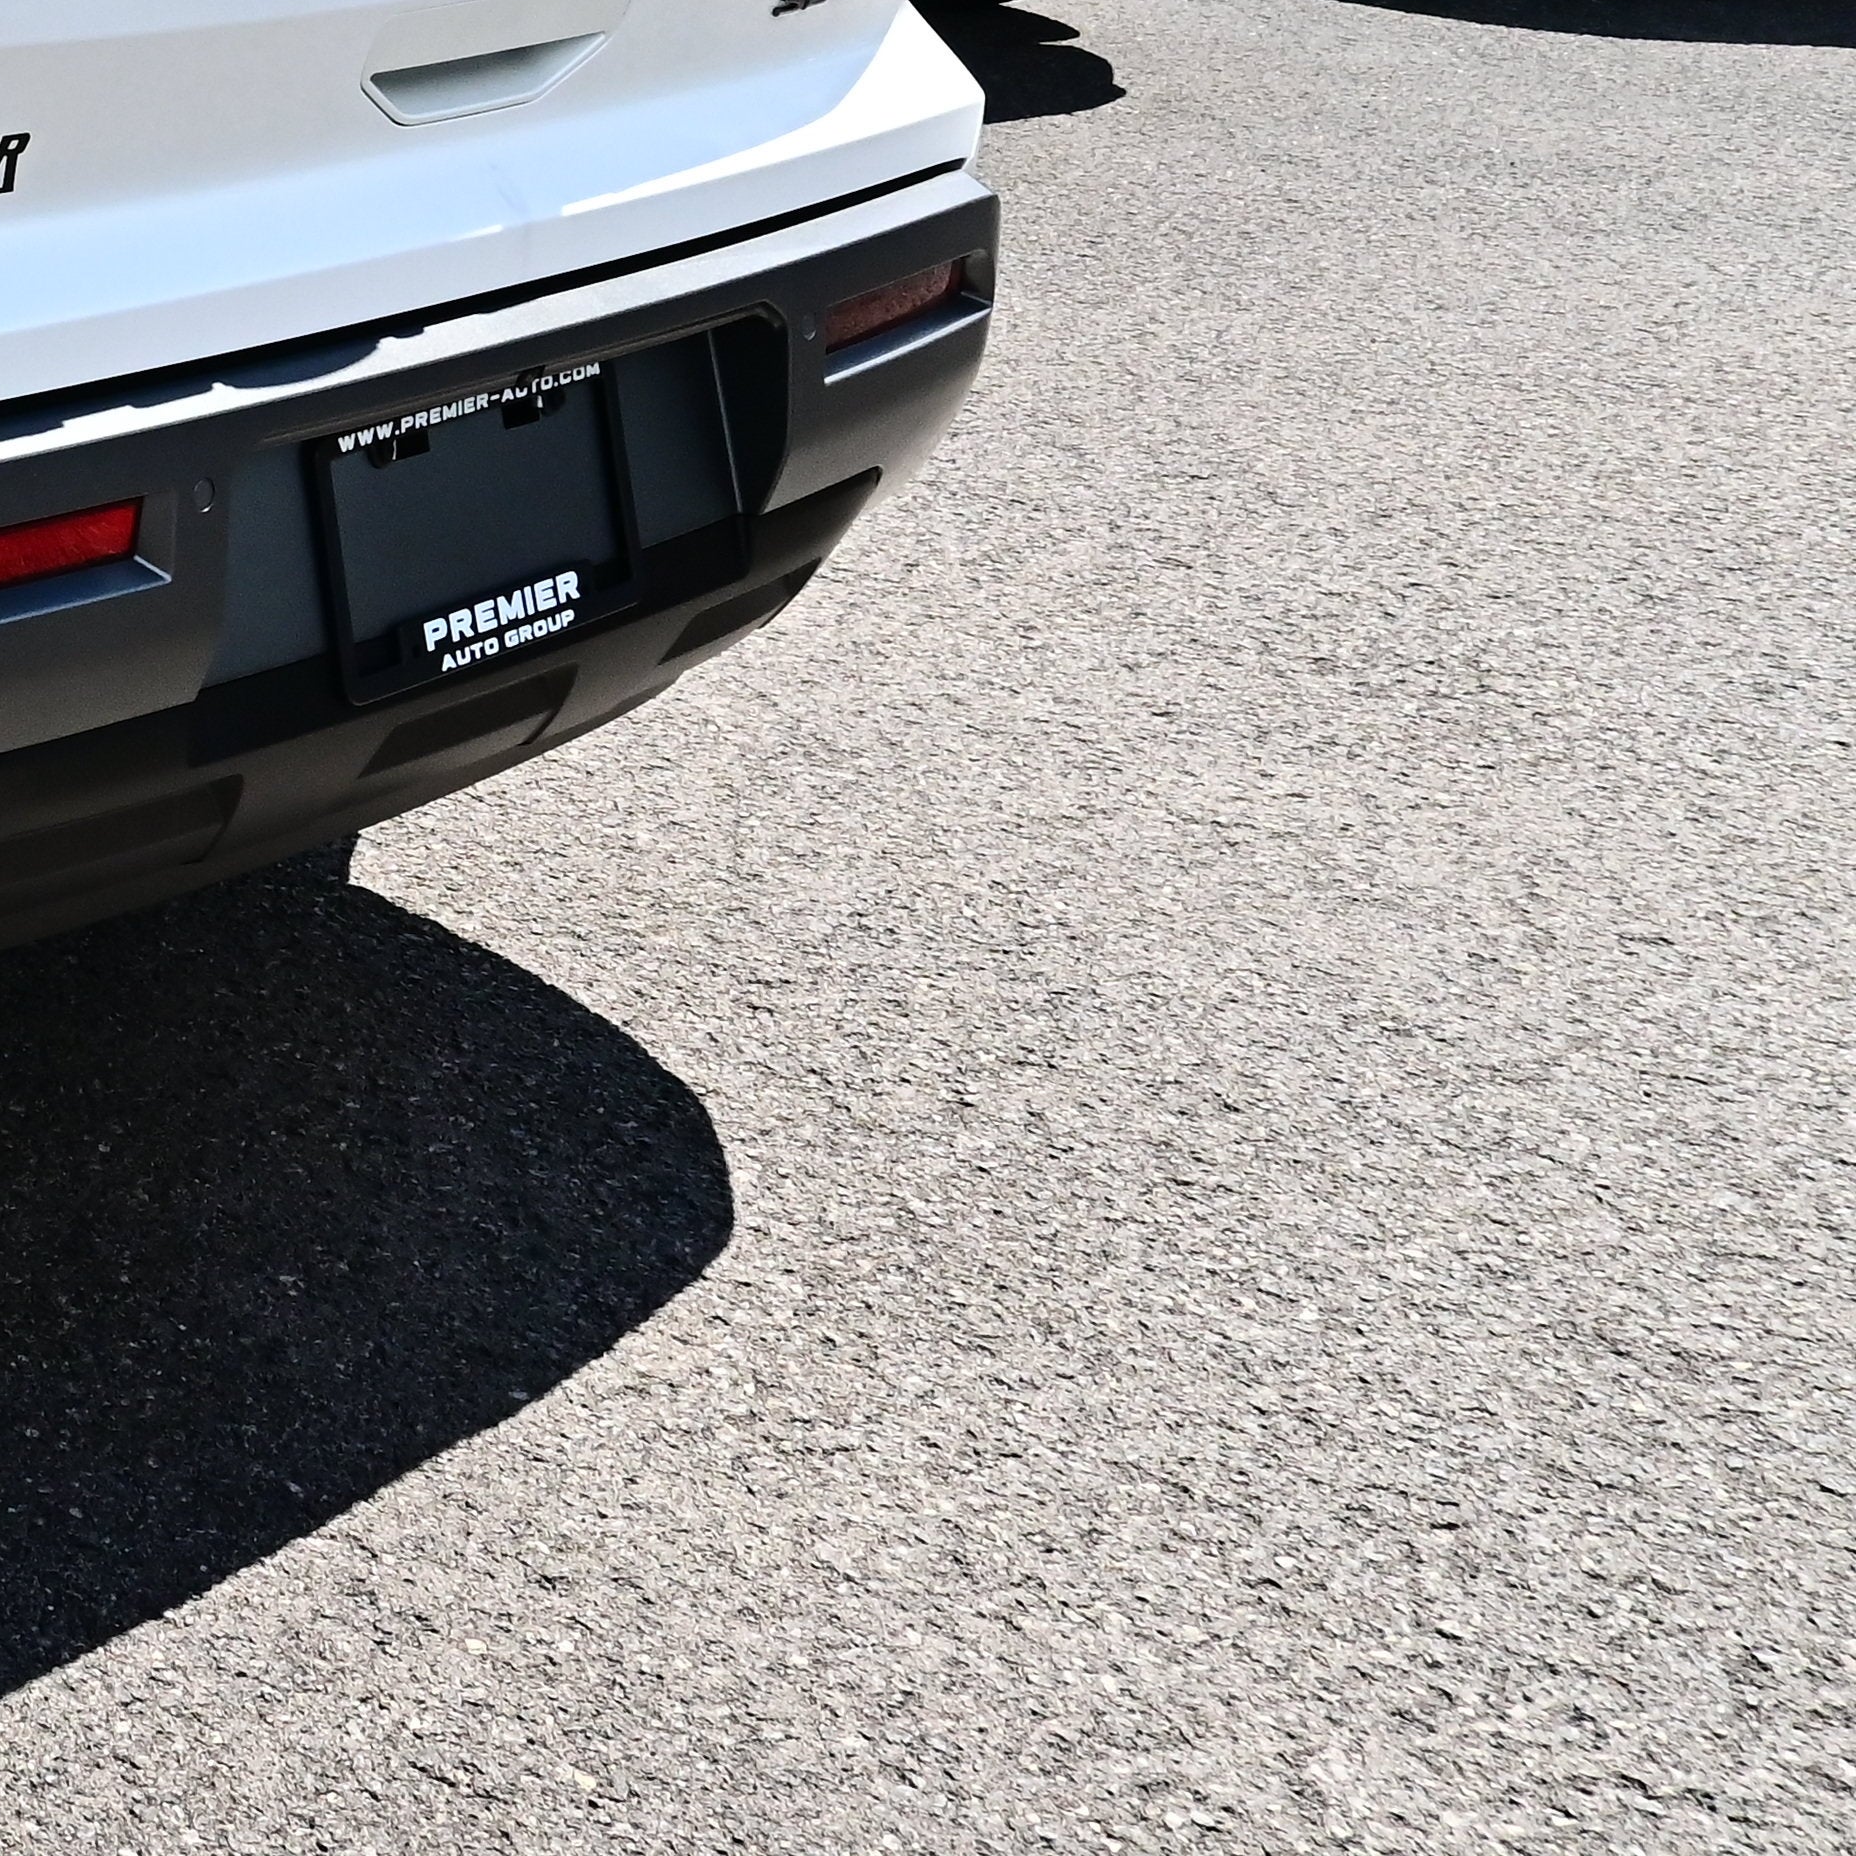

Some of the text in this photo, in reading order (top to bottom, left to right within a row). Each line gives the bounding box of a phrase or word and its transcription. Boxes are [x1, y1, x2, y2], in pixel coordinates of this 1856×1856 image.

[423, 571, 580, 652] PREMIER
[441, 609, 575, 672] AUTO GROUP
